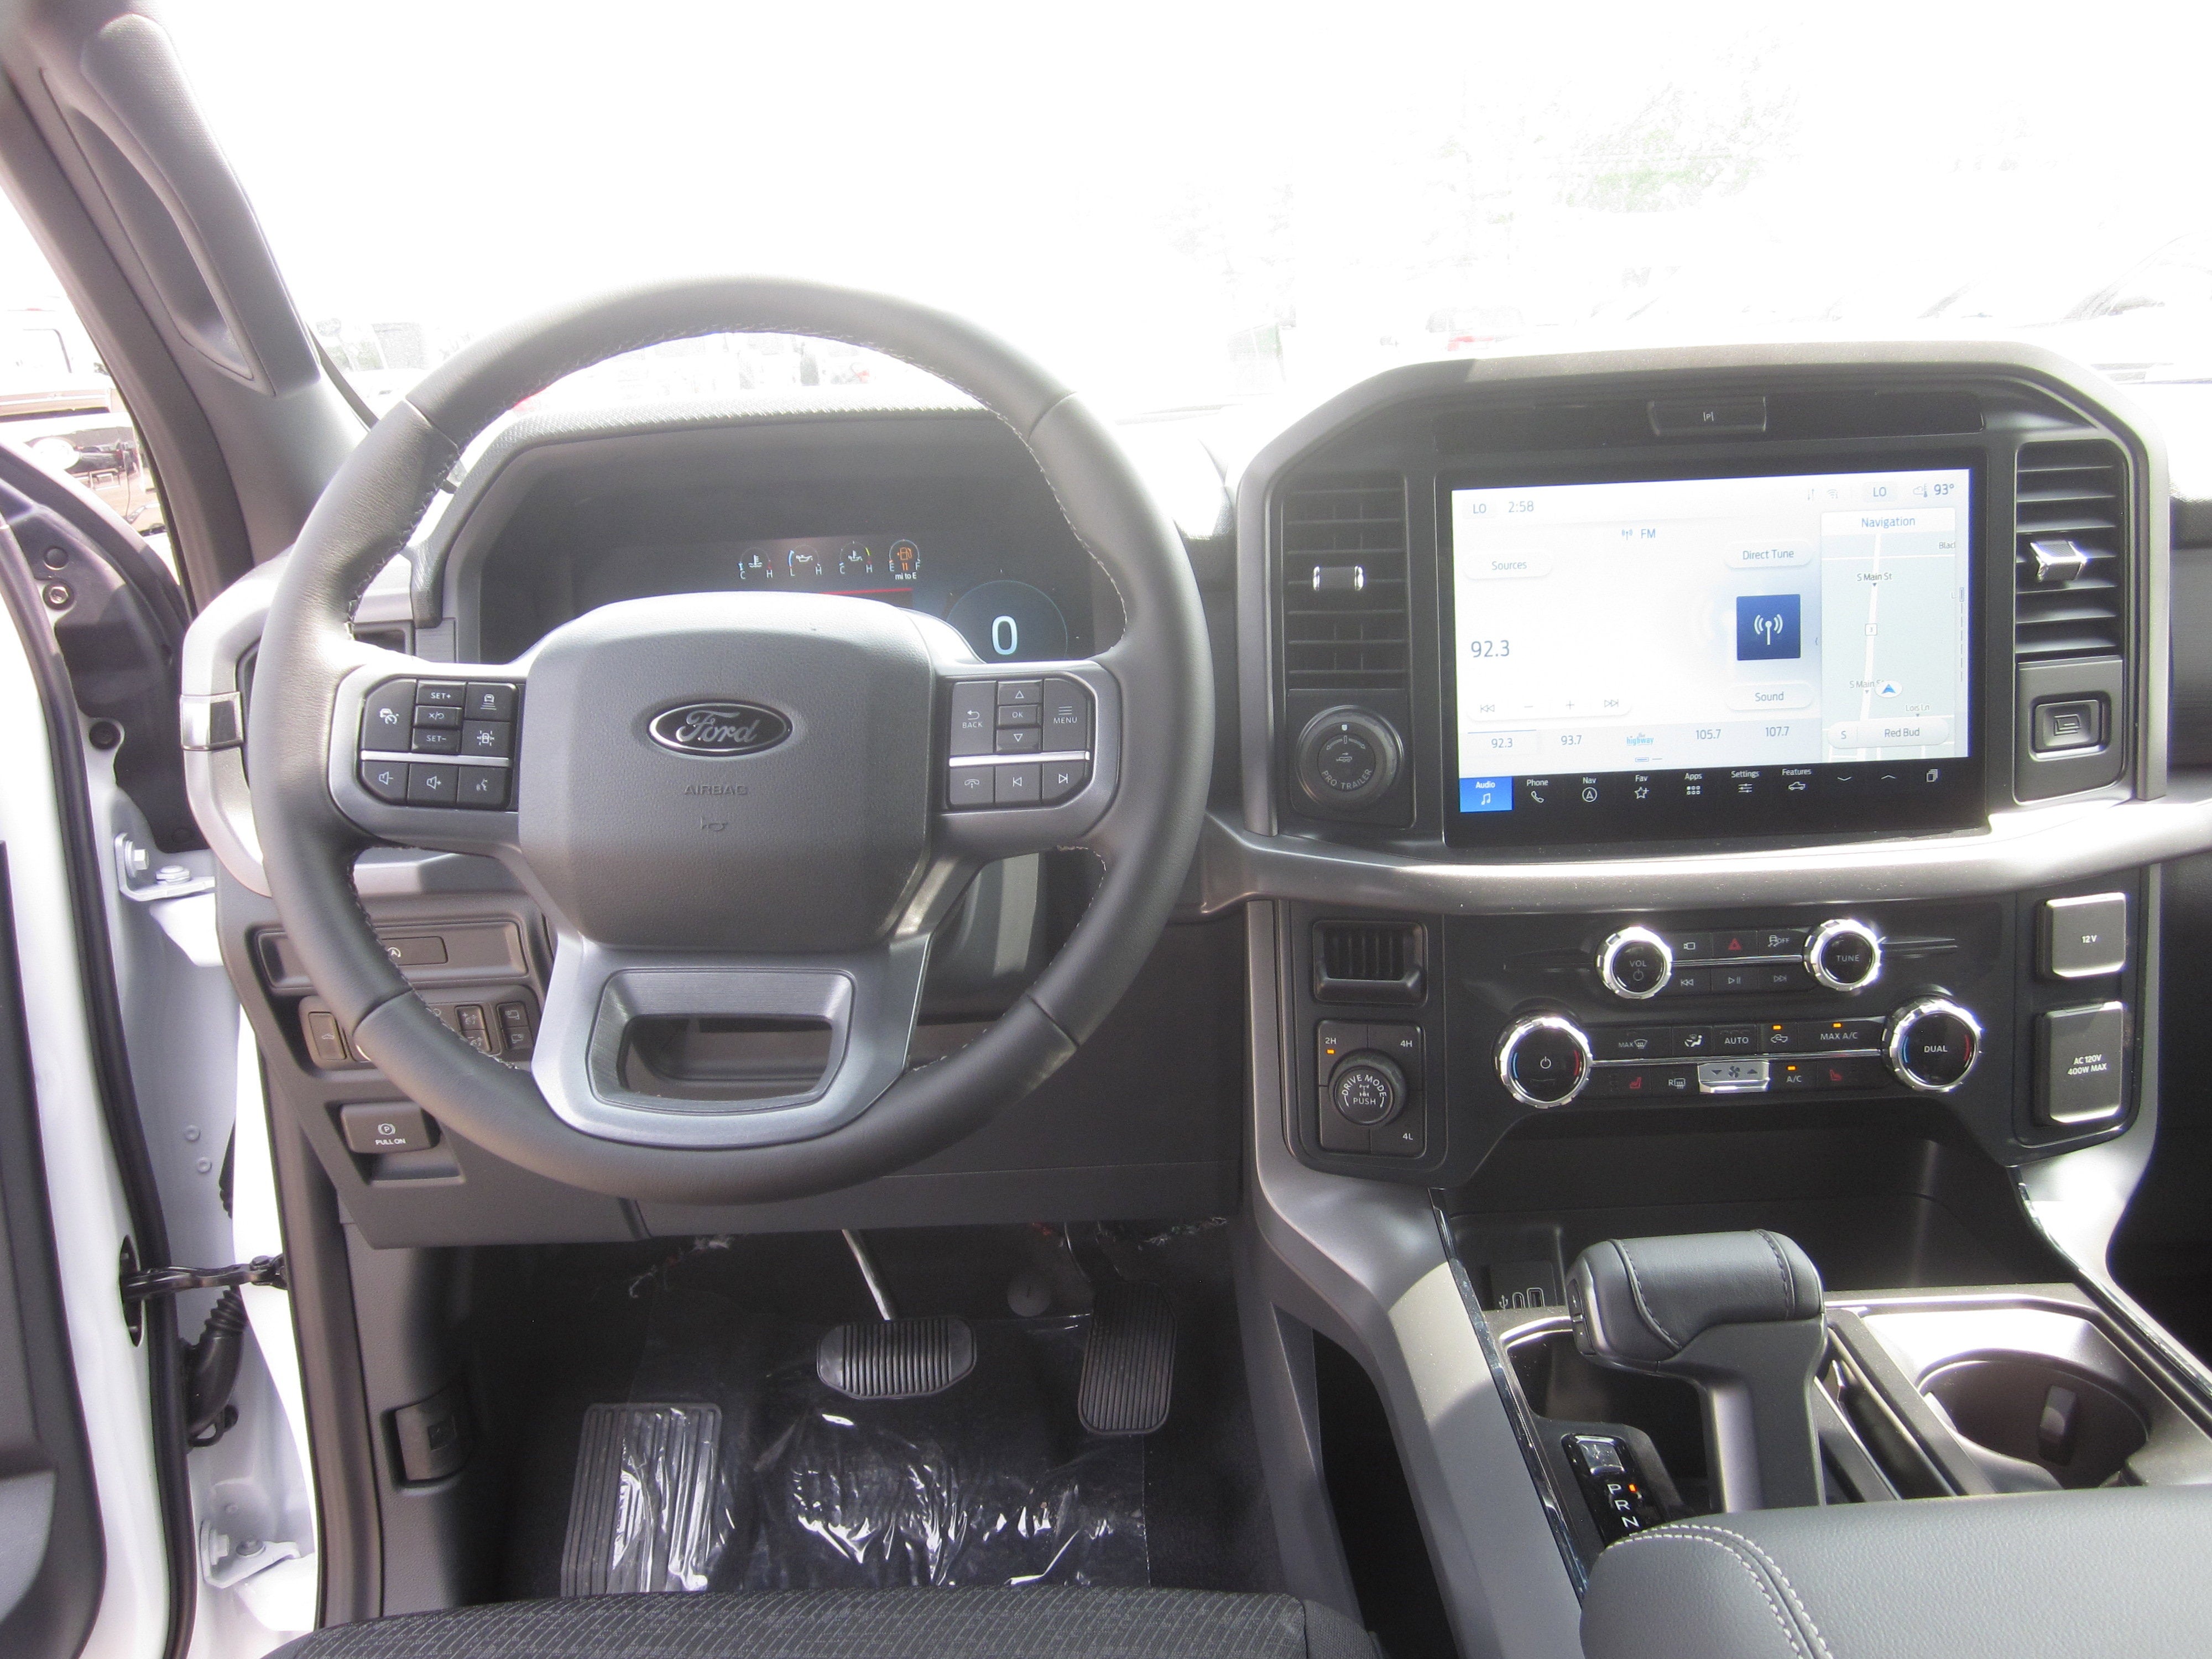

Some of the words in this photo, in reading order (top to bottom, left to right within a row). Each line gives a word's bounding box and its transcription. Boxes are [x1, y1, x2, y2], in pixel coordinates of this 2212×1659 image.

[1873, 487, 1887, 497] LO
[1473, 503, 1487, 514] LO
[1508, 500, 1534, 513] 2:58
[1861, 517, 1916, 529] Navigation
[1641, 529, 1656, 539] FM
[1743, 550, 1769, 560] Direct
[1771, 549, 1794, 559] Tune
[815, 566, 822, 575] H
[866, 564, 873, 573] H
[889, 563, 894, 571] E
[916, 562, 921, 570] F
[1491, 560, 1527, 571] Sources
[766, 570, 773, 578] H
[1864, 573, 1882, 581] Main
[992, 615, 1018, 655] 0
[1471, 640, 1510, 658] 92.3
[1856, 680, 1875, 688] Main
[1755, 692, 1784, 702] Sound
[675, 710, 760, 743] Ford
[1695, 729, 1721, 740] 105.7
[1765, 727, 1790, 737] 107.7
[1884, 729, 1901, 738] Red
[1903, 728, 1920, 737] Bud
[1491, 738, 1513, 748] 92.3
[1561, 735, 1582, 745] 93.7
[1322, 770, 1338, 786] PRO
[1340, 769, 1372, 790] TRAILER
[1684, 773, 1702, 781] Apps
[1731, 770, 1760, 779] Settings
[684, 785, 748, 795] AIRBAG
[1475, 781, 1495, 789] Audio
[2085, 1054, 2102, 1063] 120V
[2068, 1066, 2089, 1076] 400W
[2090, 1063, 2107, 1072] MAX
[1786, 1074, 1802, 1083] A/C
[1341, 1074, 1362, 1096] DRIVE
[1364, 1074, 1387, 1097] MODE
[1607, 1484, 1621, 1495] P
[1614, 1500, 1631, 1510] R
[1621, 1516, 1640, 1527] N
